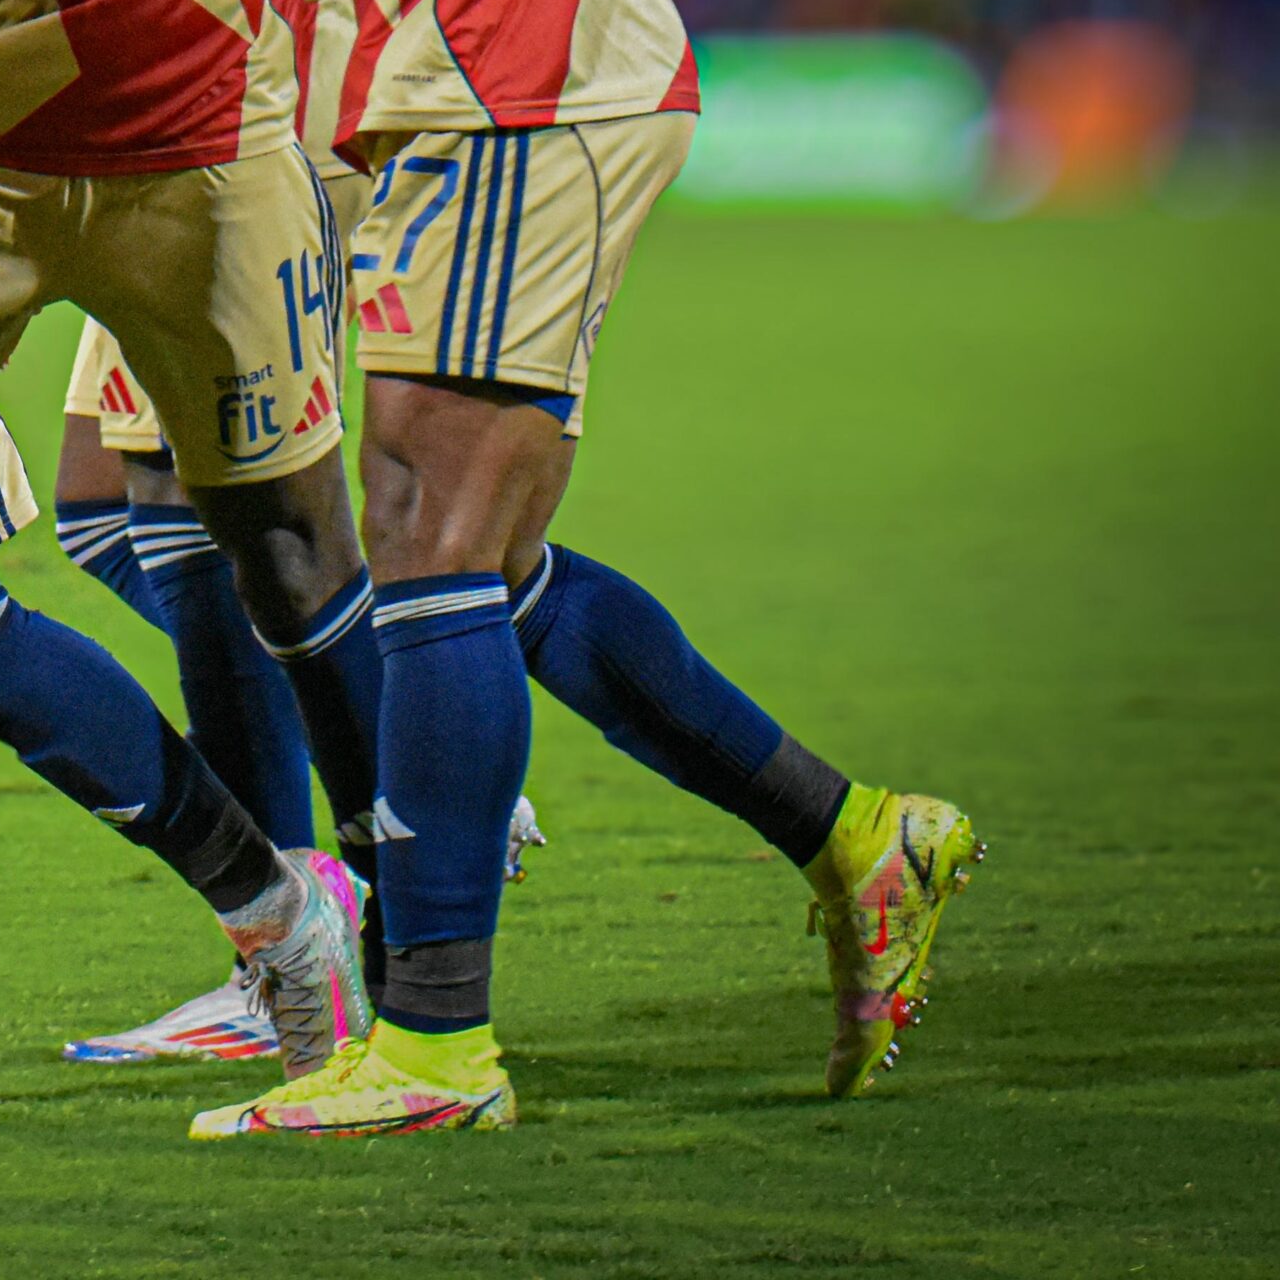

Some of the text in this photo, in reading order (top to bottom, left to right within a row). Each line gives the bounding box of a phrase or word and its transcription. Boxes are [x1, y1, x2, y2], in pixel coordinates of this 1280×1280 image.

[276, 248, 331, 373] 14
[214, 363, 274, 389] smart
[217, 391, 281, 446] fit
